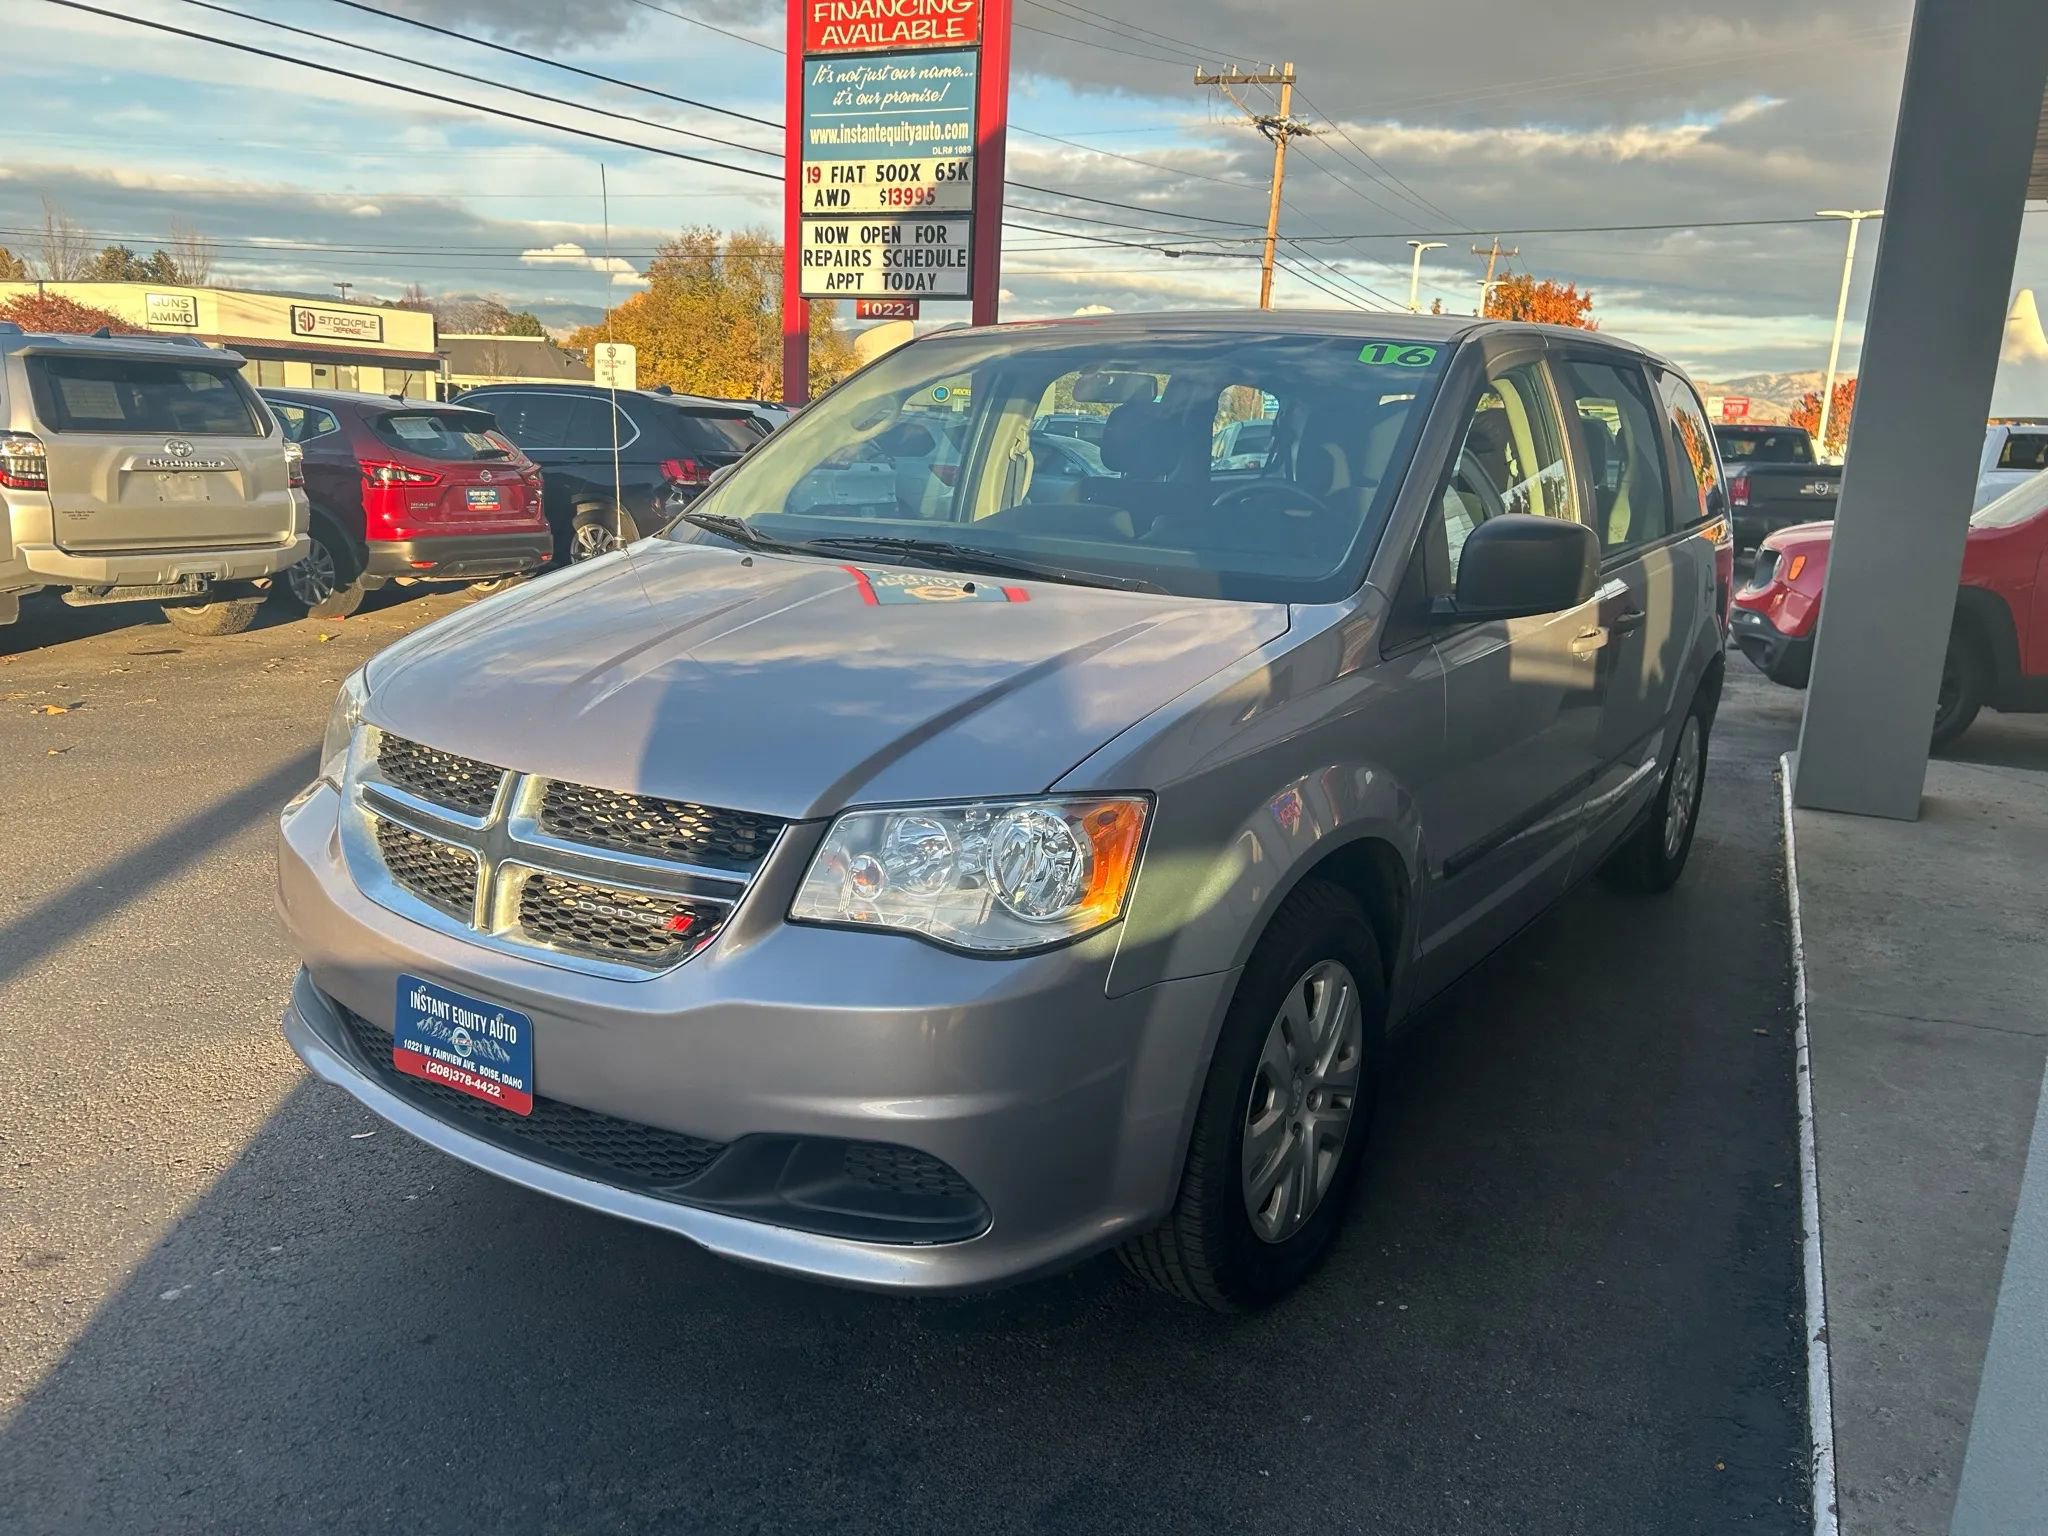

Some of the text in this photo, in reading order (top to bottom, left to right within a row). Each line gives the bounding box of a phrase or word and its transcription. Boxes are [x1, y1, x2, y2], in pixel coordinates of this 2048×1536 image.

[814, 0, 974, 23] FINANCING
[820, 17, 965, 46] AVAILABLE
[812, 64, 974, 90] It's not just our name...
[832, 82, 949, 110] it's our promise!
[809, 120, 969, 147] www.instantequityauto.com
[954, 146, 972, 154] 1089
[806, 162, 969, 183] 19 FIAT 500X 65K
[814, 187, 936, 207] AWD $13995
[814, 225, 947, 244] NOW OPEN FOR
[803, 248, 966, 267] REPAIRS SCHEDULE
[826, 272, 937, 290] APPT TODAY
[151, 297, 189, 308] GUNS
[861, 303, 914, 316] 10221
[151, 312, 193, 323] AMMO
[318, 315, 377, 329] STOCKPILE
[1369, 344, 1431, 364] 16
[578, 900, 671, 929] DODGE
[410, 990, 517, 1044] INSTANT EQUITY AUTO
[403, 1039, 523, 1090] 10221 W. FAIRVIEW AVE. BOISE, IDAHO
[425, 1060, 501, 1098] (208)378-4422
